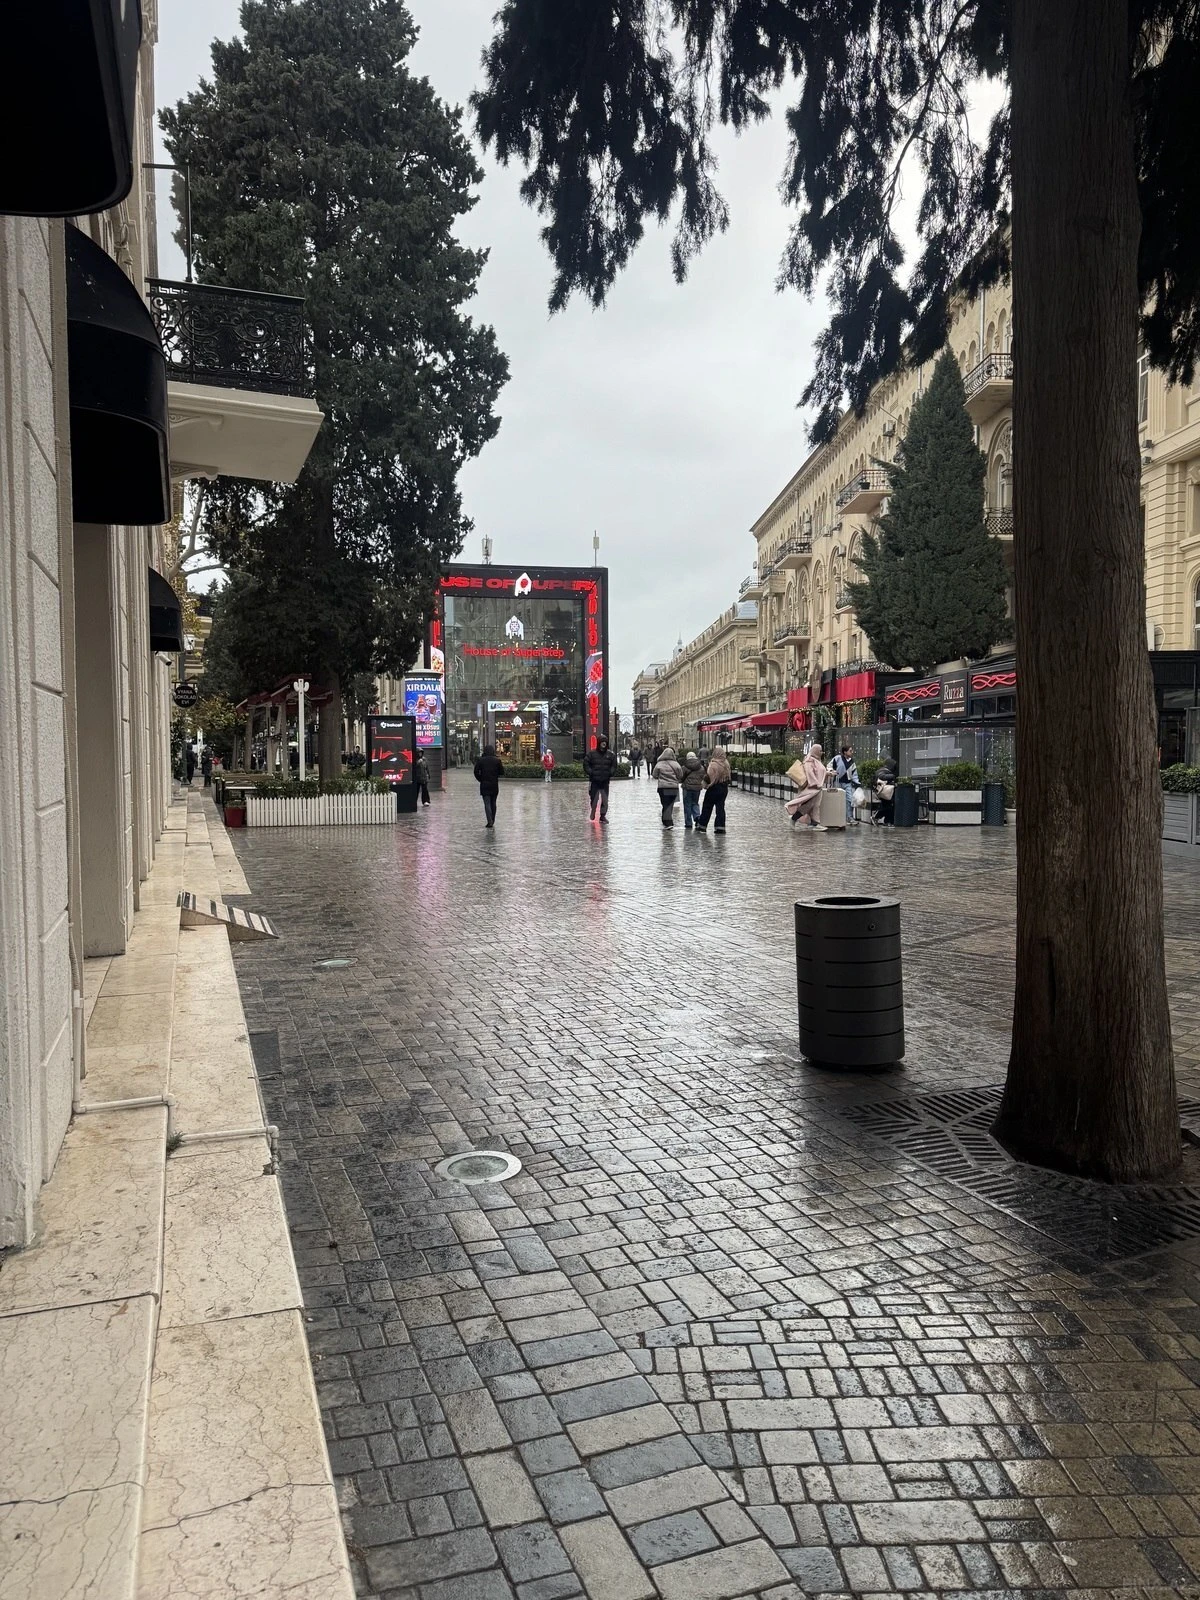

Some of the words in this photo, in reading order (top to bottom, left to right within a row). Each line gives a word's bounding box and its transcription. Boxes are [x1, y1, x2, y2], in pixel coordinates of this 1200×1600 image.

[486, 578, 515, 589] OF
[463, 643, 498, 656] House
[501, 647, 512, 656] of
[944, 684, 964, 700] Ruzza
